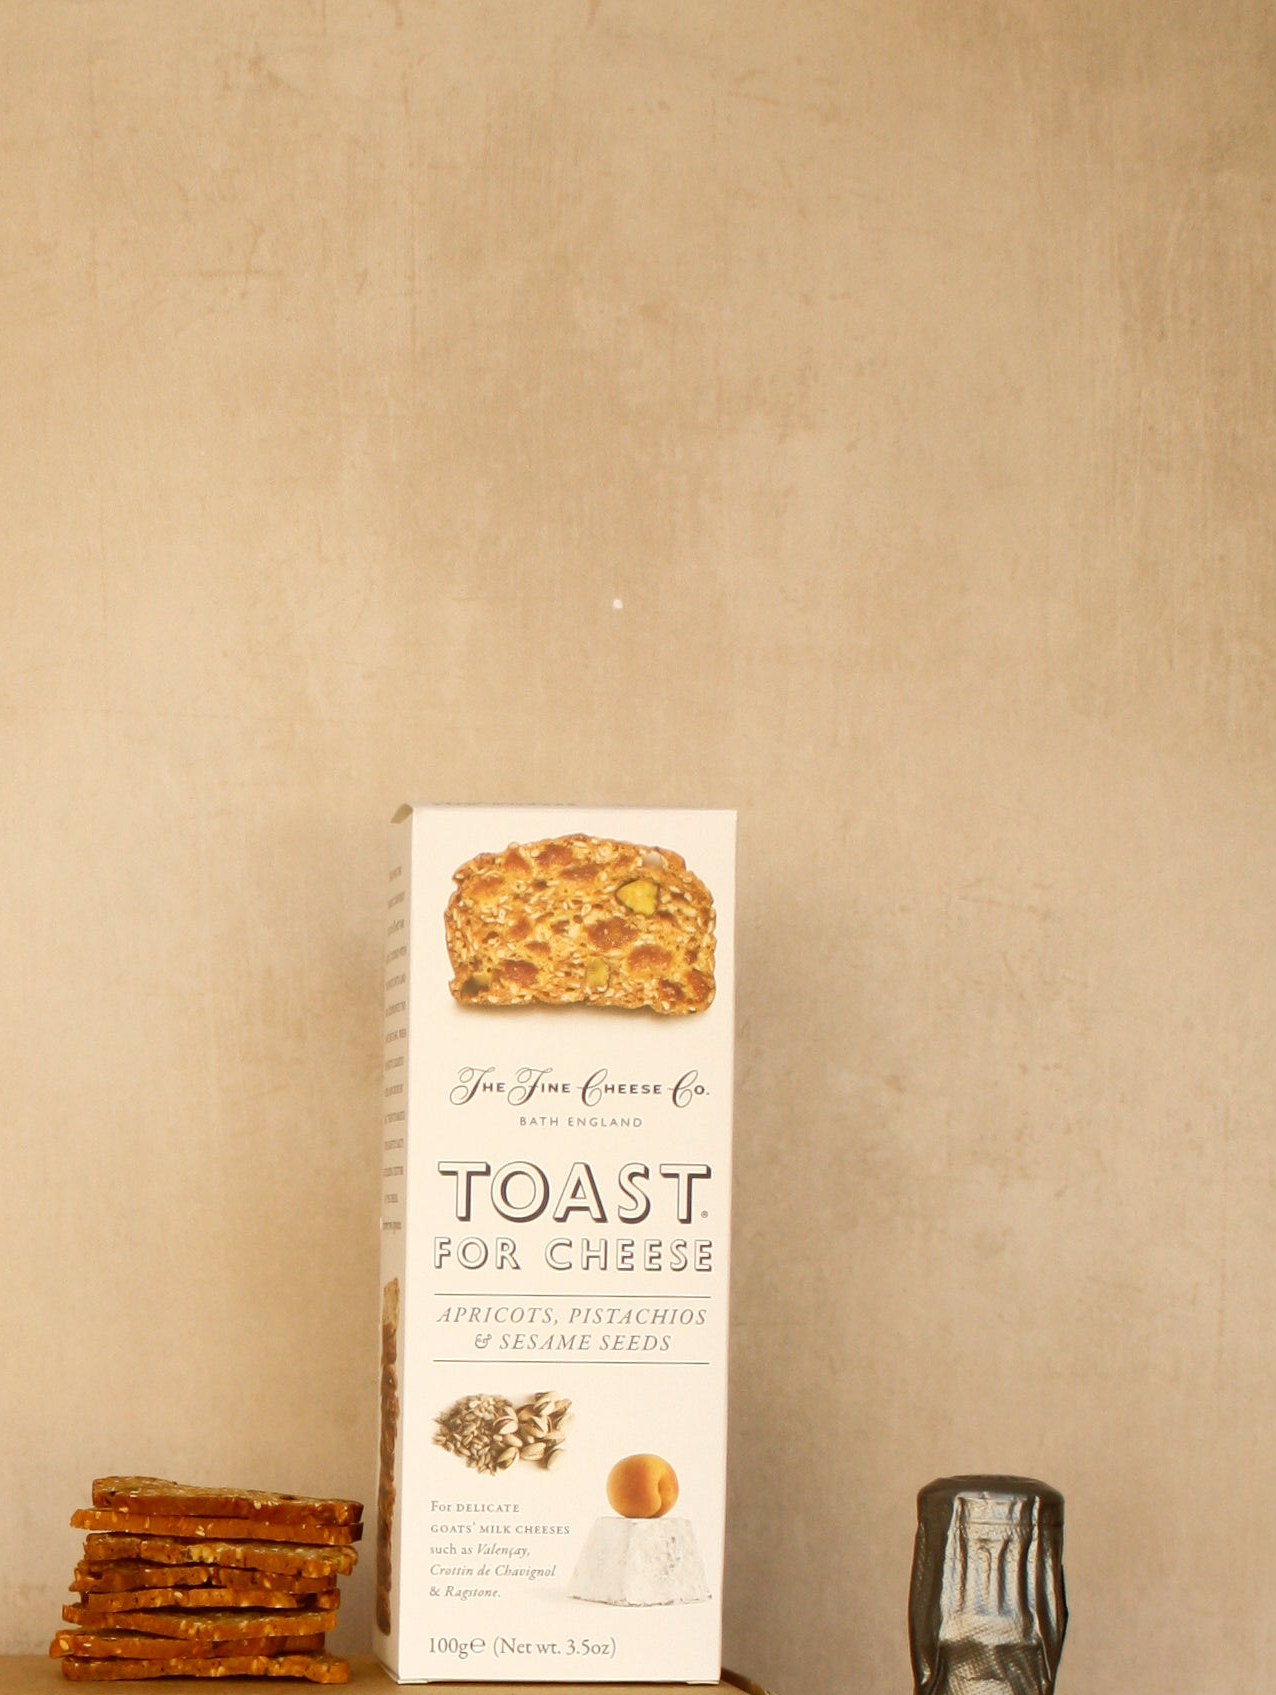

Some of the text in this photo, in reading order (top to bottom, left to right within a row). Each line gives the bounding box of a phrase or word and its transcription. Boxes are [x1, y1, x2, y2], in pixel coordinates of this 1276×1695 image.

[519, 1116, 643, 1128] BATH ENGLAND
[437, 1160, 712, 1223] TOAST
[433, 1236, 713, 1273] FOR CHEESE
[436, 1306, 708, 1326] APRICOTS, PISTACHIOS
[474, 1333, 672, 1352] & SESAME SEEDS
[456, 1503, 520, 1513] DELICATE
[479, 1524, 511, 1535] MILK
[515, 1524, 570, 1535] CHEESES
[429, 1544, 457, 1556] such
[461, 1546, 473, 1556] as
[430, 1564, 557, 1580] Crottin de Chavignol
[429, 1585, 501, 1602] & Ragstone.
[493, 1637, 532, 1658] (Net
[536, 1639, 562, 1655] wt.
[566, 1637, 617, 1659] 3.5oz)
